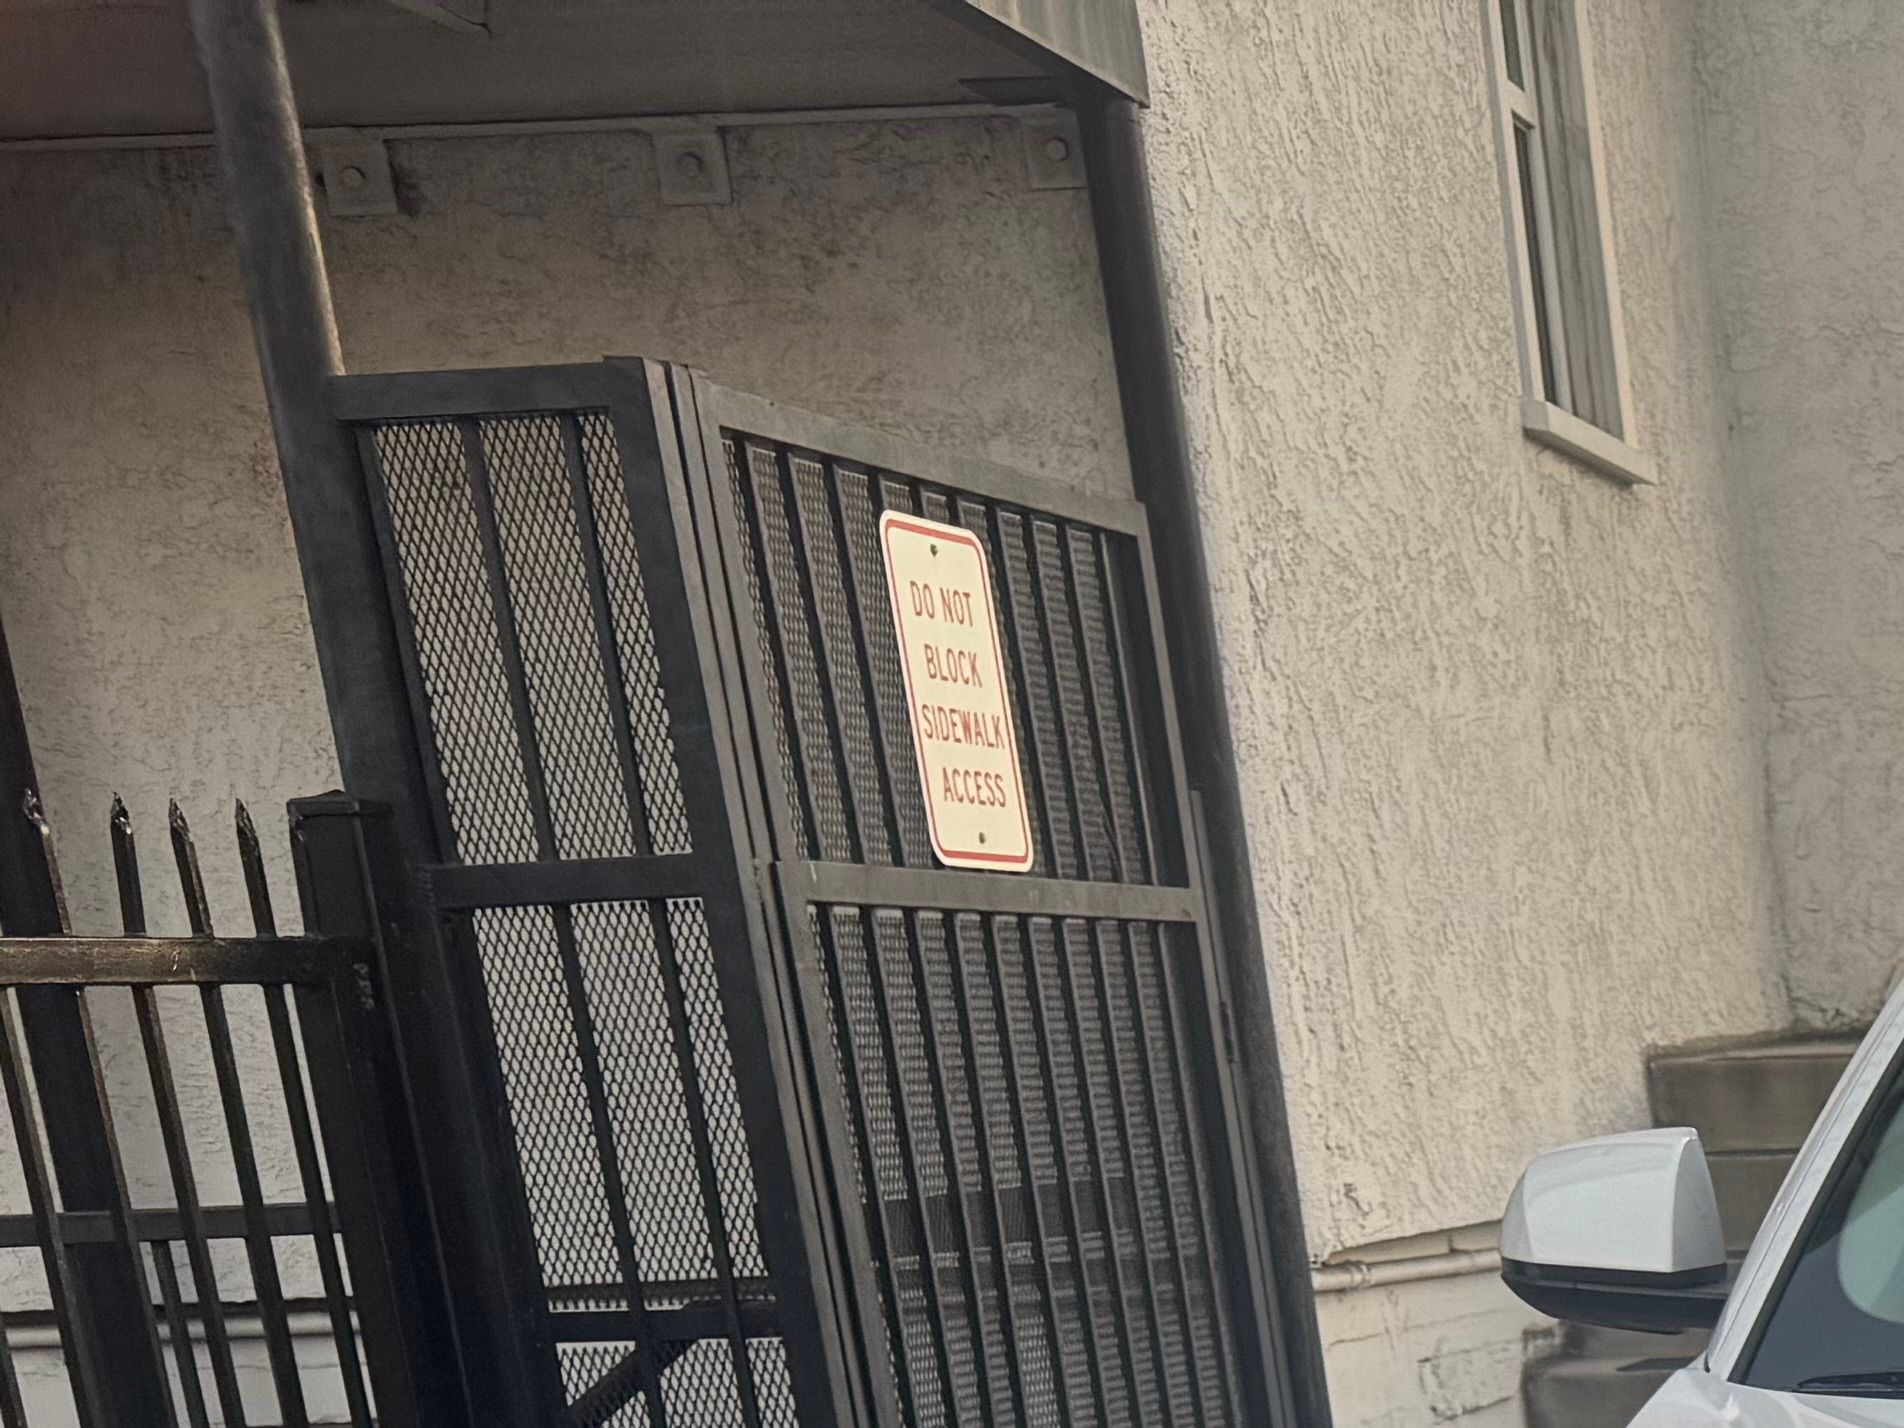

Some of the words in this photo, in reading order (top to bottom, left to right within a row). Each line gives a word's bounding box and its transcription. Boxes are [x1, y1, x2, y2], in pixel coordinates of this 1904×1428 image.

[909, 580, 935, 619] DO
[939, 587, 974, 627] NOT
[923, 643, 983, 688] BLOCK
[921, 703, 1006, 750] SIDEWALK
[941, 766, 1007, 808] ACCESS
